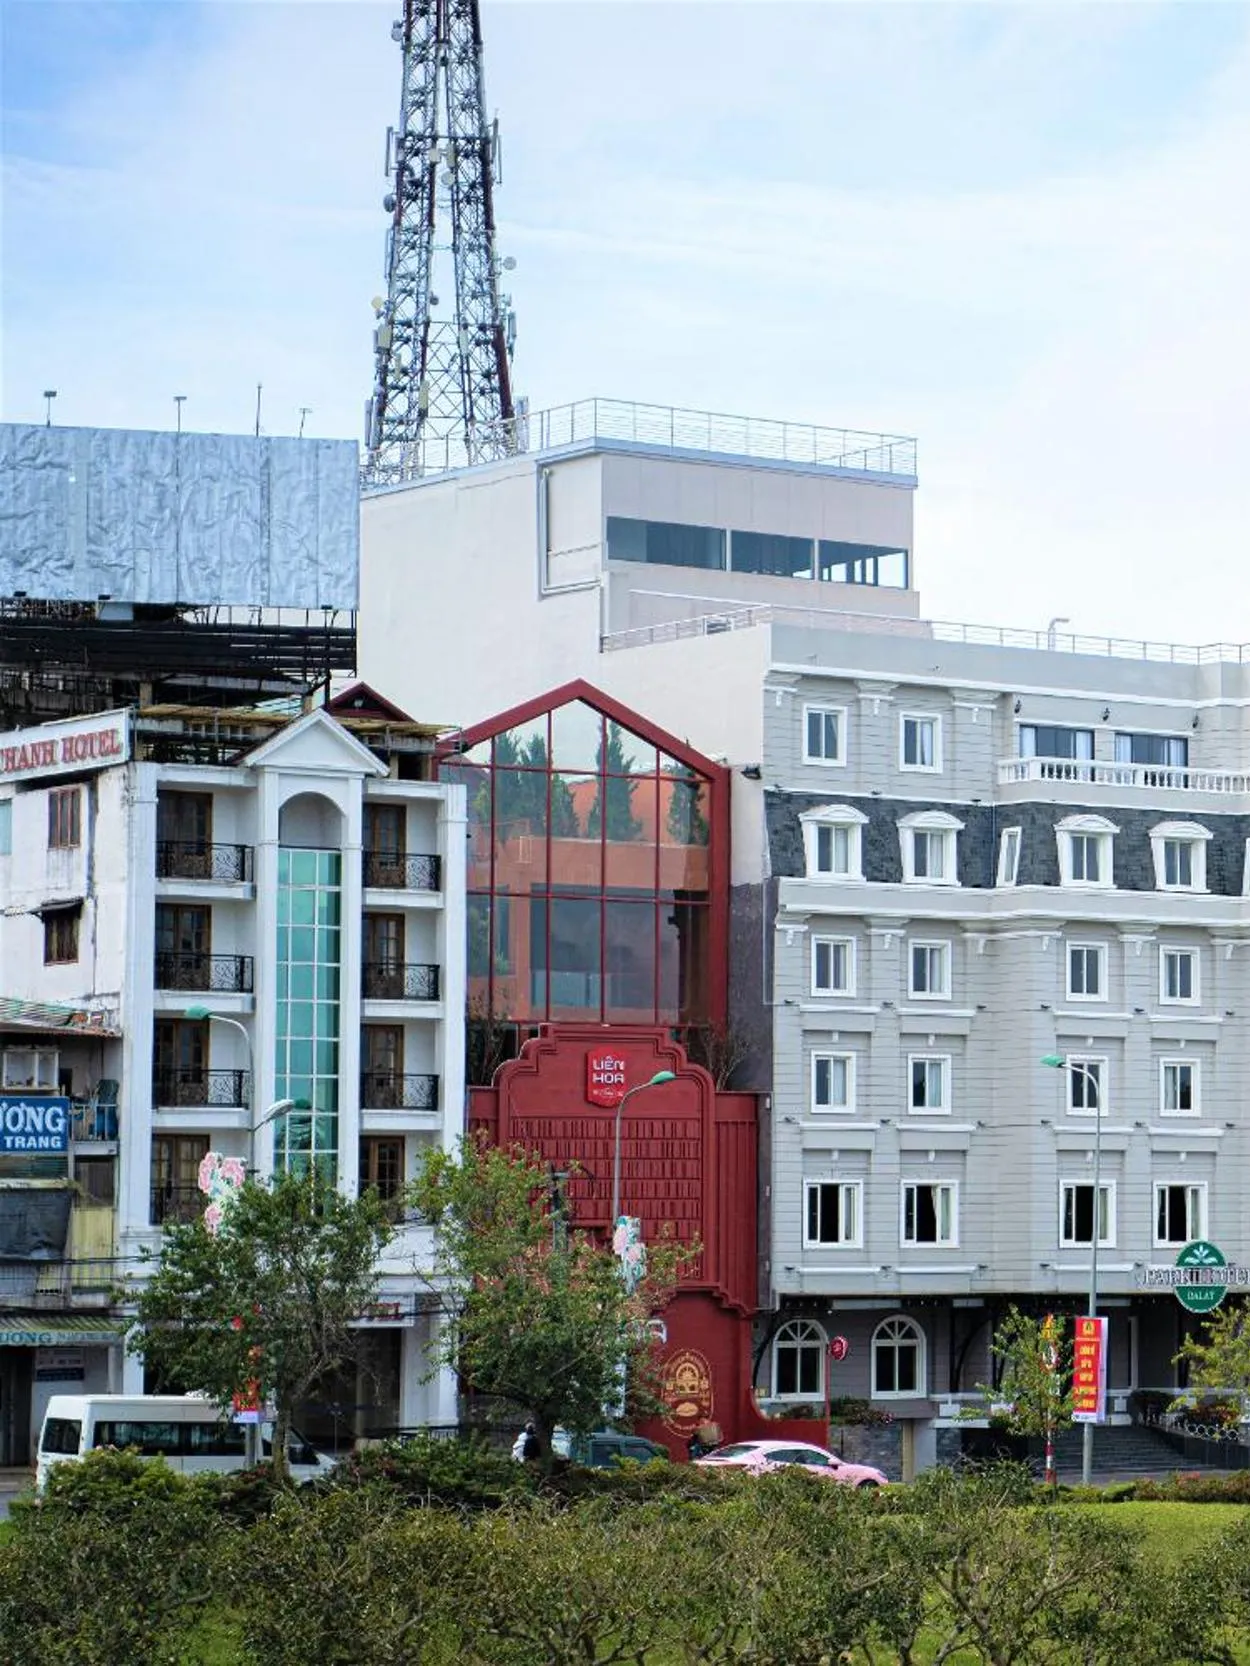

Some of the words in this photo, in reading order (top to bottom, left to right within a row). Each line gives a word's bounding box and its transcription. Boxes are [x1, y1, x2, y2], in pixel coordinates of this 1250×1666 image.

[0, 739, 58, 773] HANH
[61, 728, 121, 763] HOTEL
[592, 1055, 625, 1070] LIÊN
[592, 1072, 625, 1084] HOA
[0, 1102, 66, 1133] ƠNG
[4, 1135, 62, 1149] TRANG
